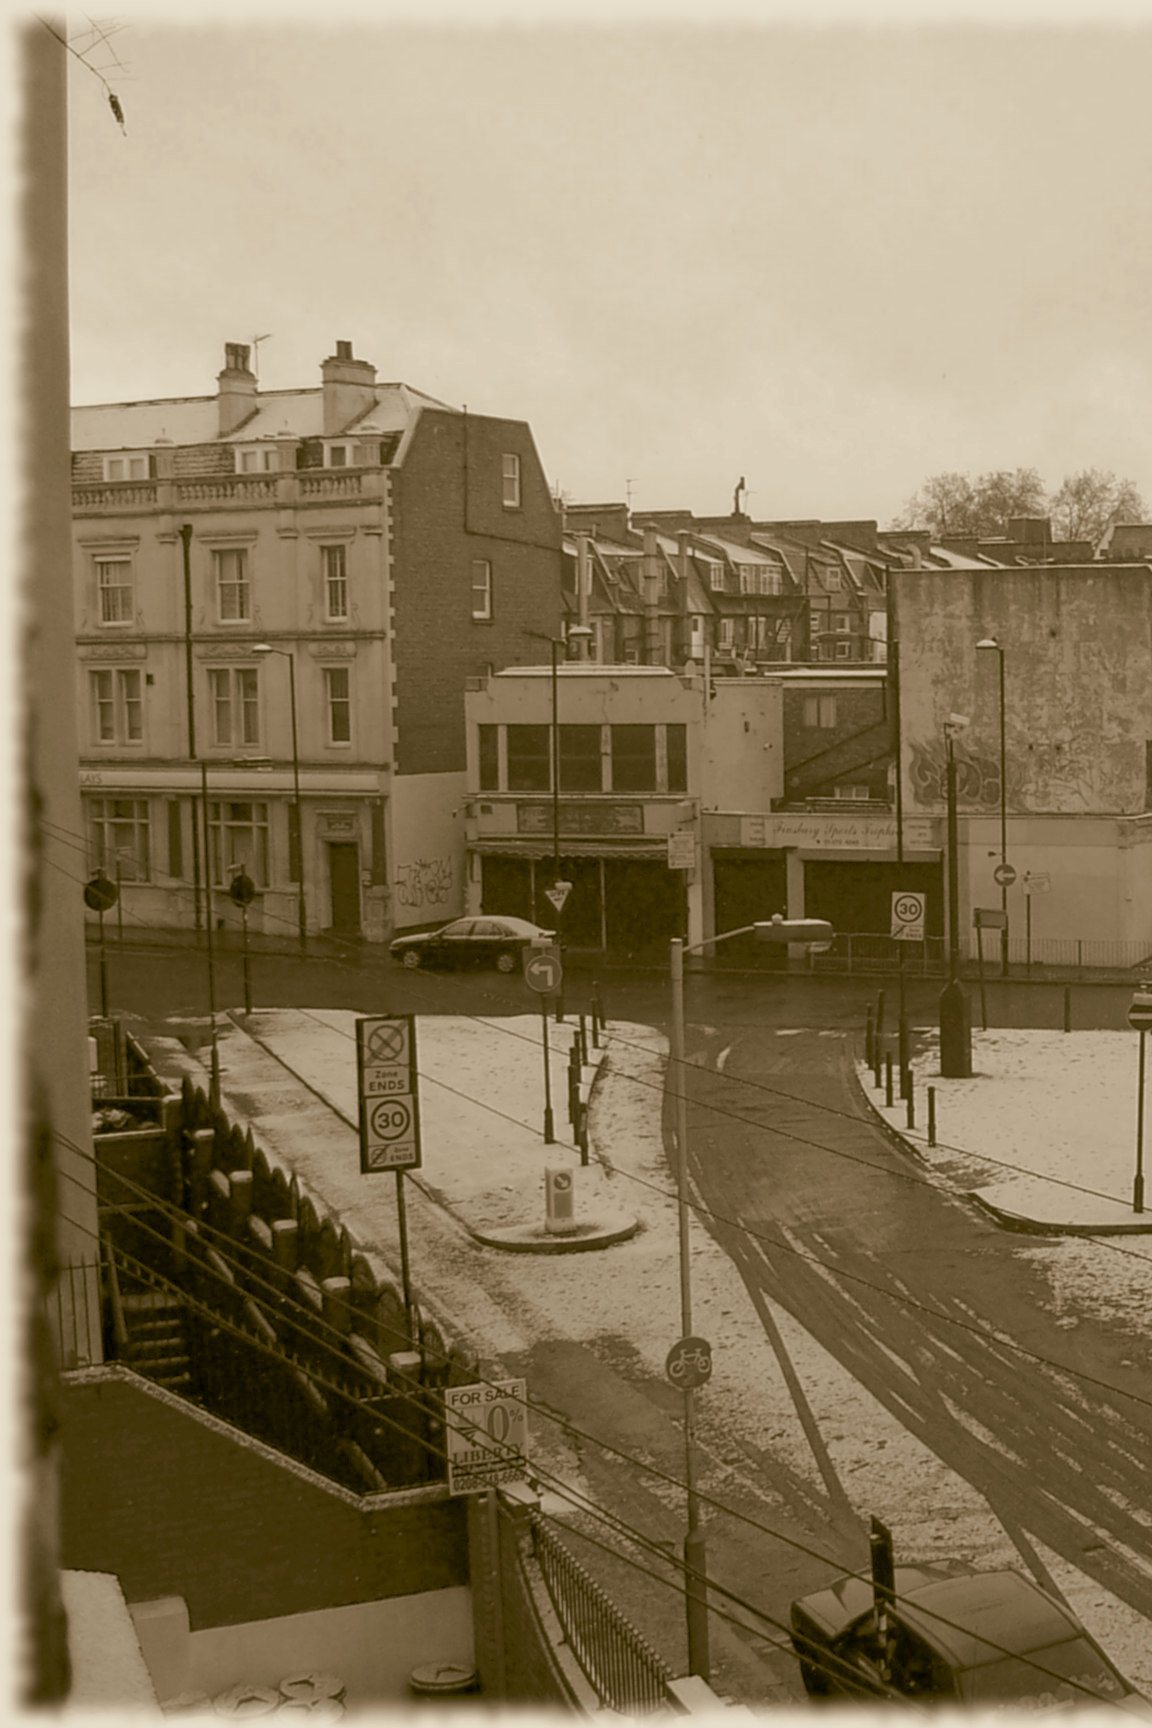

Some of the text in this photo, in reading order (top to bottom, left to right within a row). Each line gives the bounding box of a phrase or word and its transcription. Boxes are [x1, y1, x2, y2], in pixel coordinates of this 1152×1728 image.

[773, 821, 820, 840] Finsbury
[824, 821, 857, 838] Sports
[900, 903, 918, 915] 30
[375, 1070, 398, 1080] Zone
[369, 1080, 405, 1092] ENDS
[378, 1111, 405, 1129] 30
[390, 1153, 414, 1162] ENDS
[451, 1385, 520, 1406] FOR SALE
